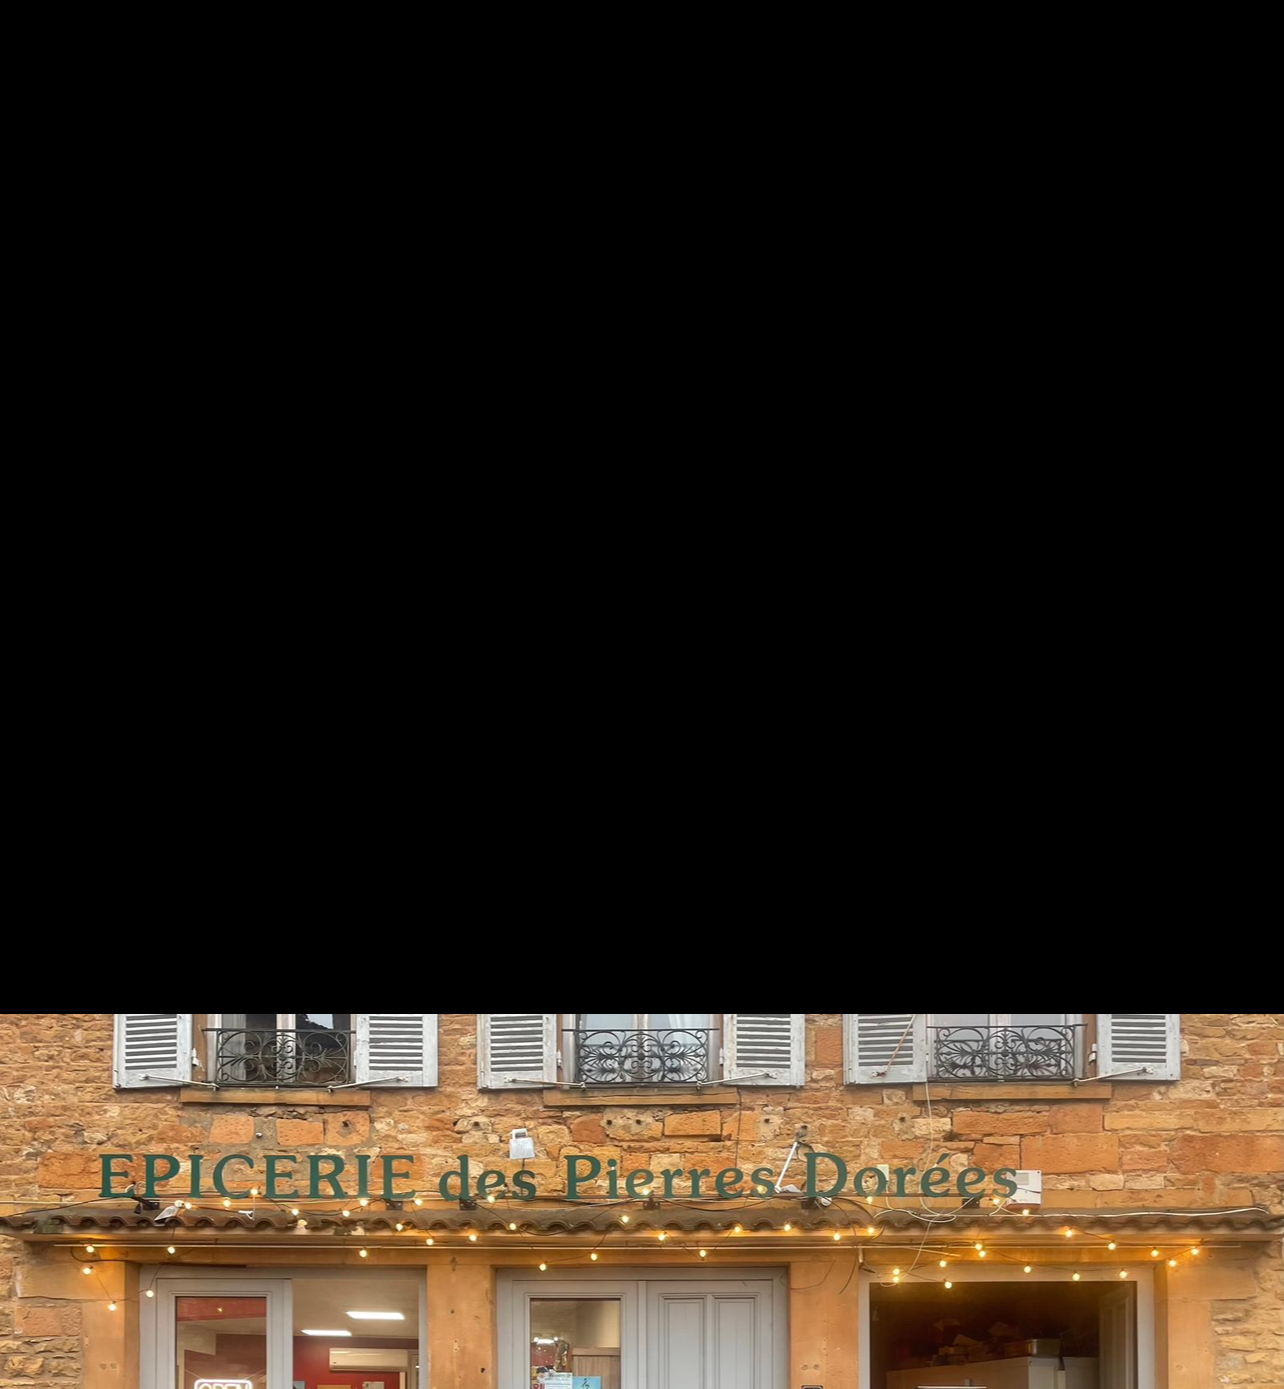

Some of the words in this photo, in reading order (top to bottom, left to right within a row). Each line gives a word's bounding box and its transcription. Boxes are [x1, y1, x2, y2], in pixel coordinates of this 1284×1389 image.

[98, 1153, 417, 1200] EPICERIE
[438, 1154, 537, 1200] des
[564, 1154, 776, 1200] Pierres
[803, 1152, 1018, 1198] Dorées
